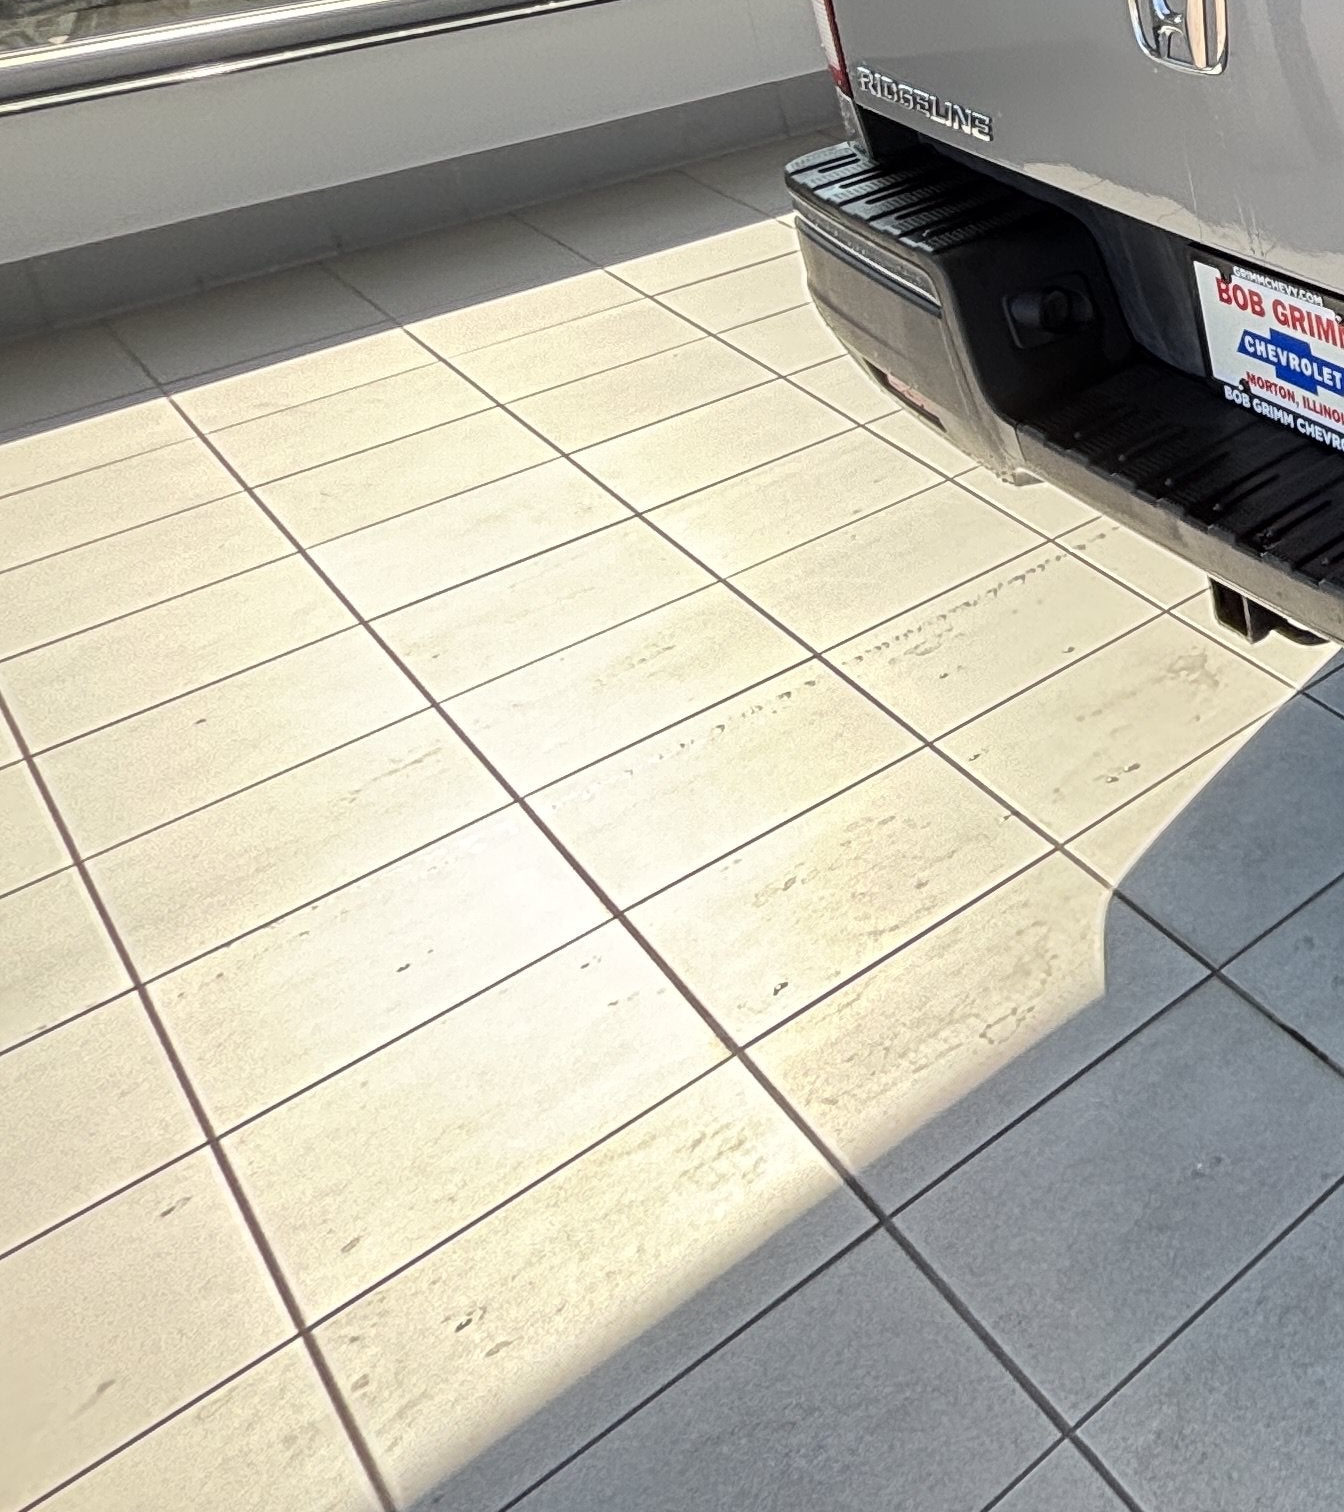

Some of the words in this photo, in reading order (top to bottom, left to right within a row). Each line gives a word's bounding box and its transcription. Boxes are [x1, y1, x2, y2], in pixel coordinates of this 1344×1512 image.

[856, 66, 993, 142] RIDGELINE
[1215, 277, 1266, 318] BOB
[1232, 266, 1324, 307] GRIMMCHEVY.COM
[1244, 335, 1342, 390] CHEVROLET
[1224, 385, 1251, 408] BOB
[1252, 398, 1295, 428] GRIMM
[1245, 371, 1300, 408] MORTON,
